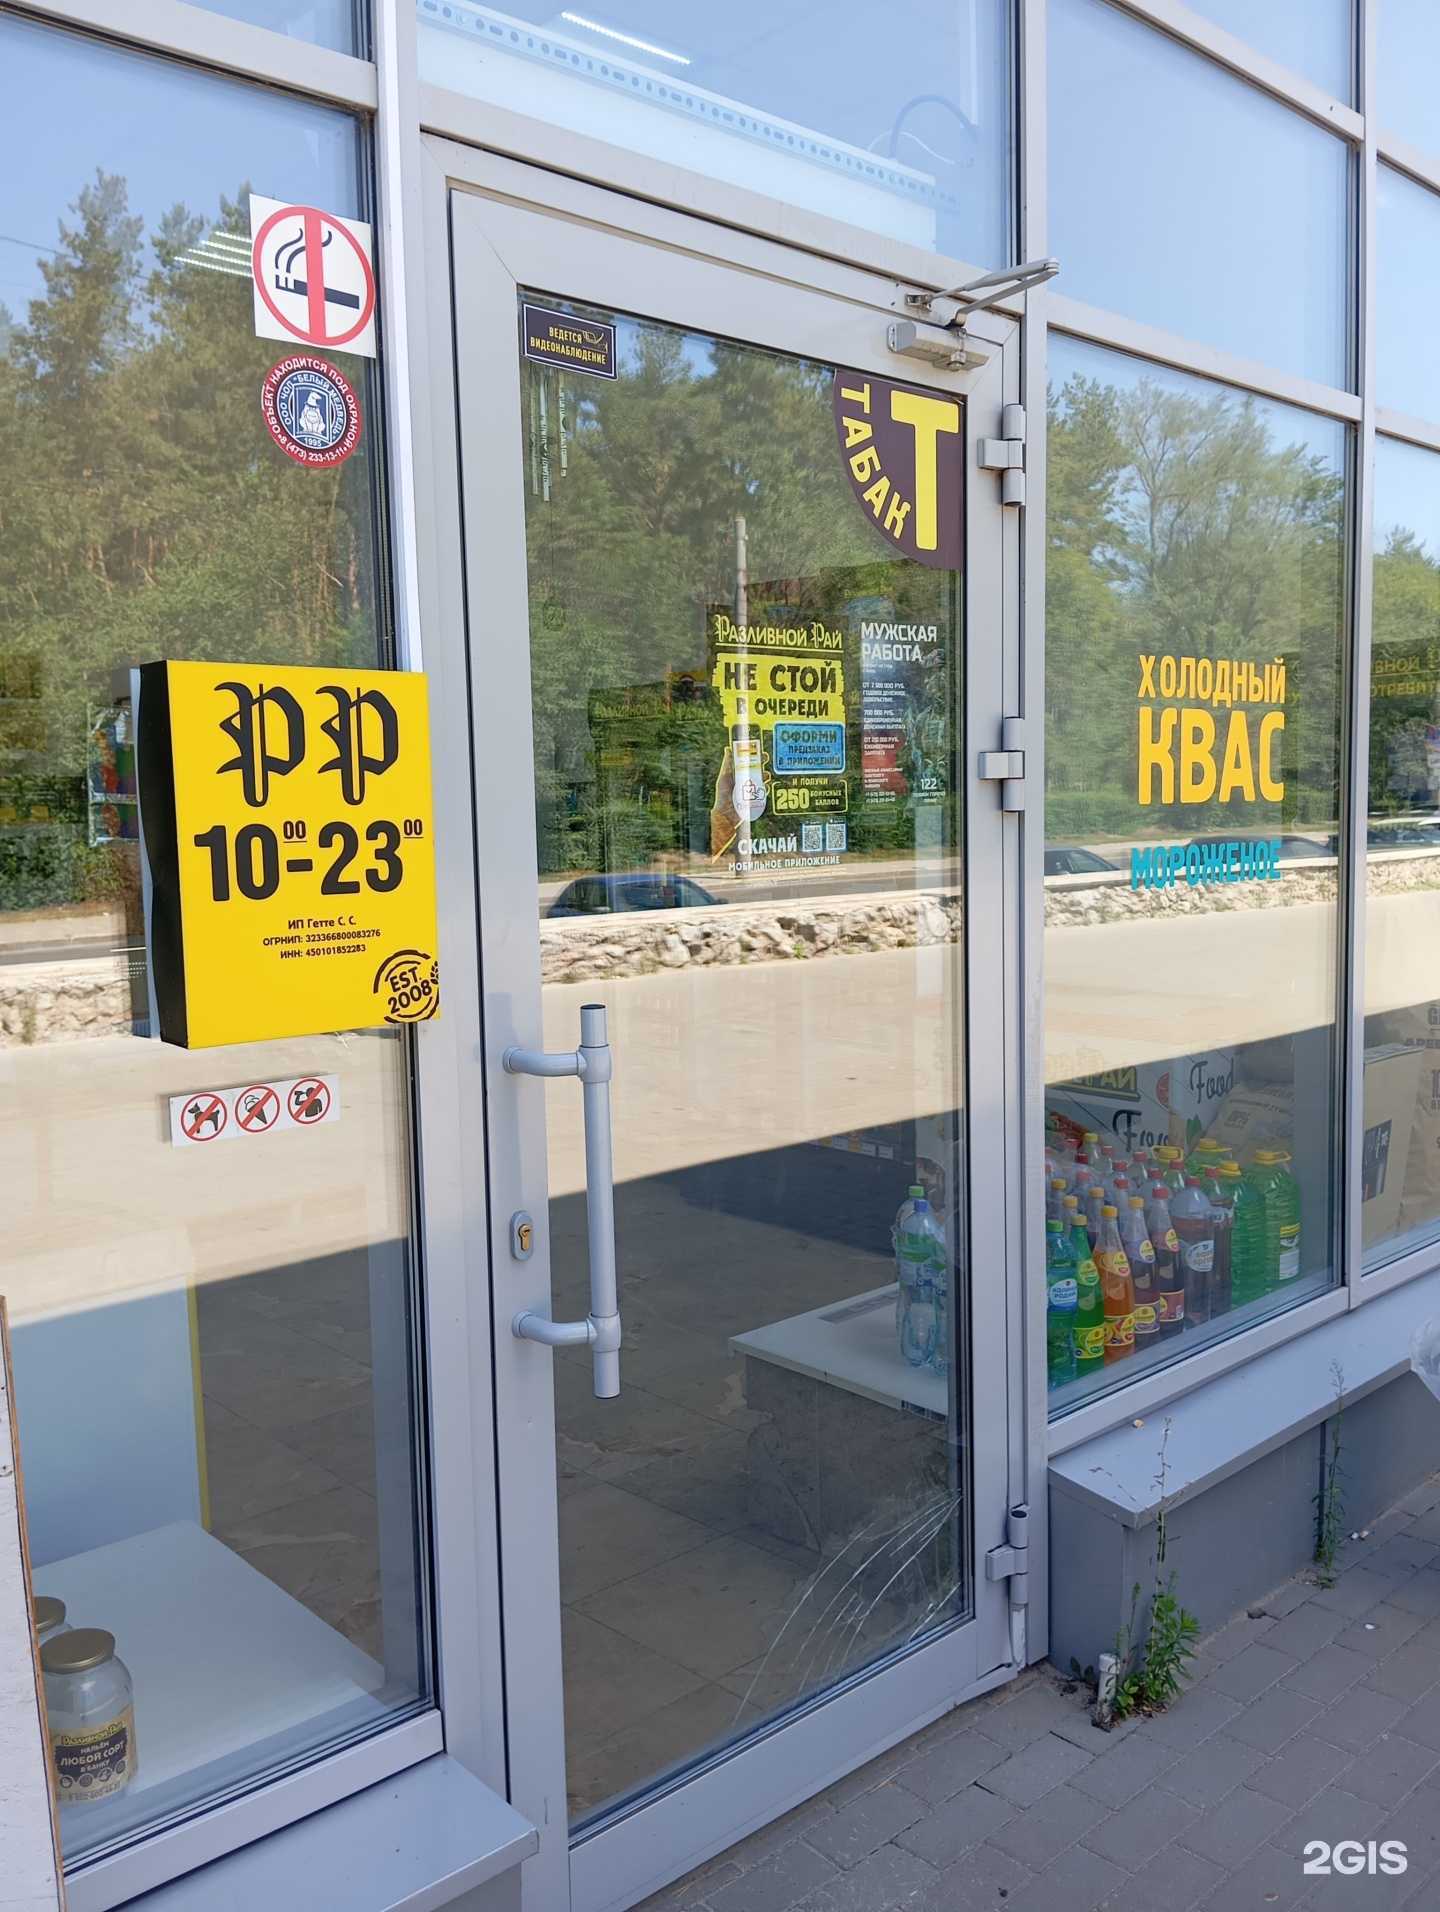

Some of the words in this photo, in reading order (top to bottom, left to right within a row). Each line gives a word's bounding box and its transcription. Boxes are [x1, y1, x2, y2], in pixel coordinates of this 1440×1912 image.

[549, 326, 582, 344] ВЕДЕТСЯ
[530, 336, 606, 365] ВИДЕОНАБЛЮДЕНИЕ
[270, 357, 328, 384] НАХОДИТСЯ
[328, 369, 349, 394] ПОД
[264, 384, 281, 434] ОБЪЕКТ
[343, 394, 358, 448] ОХРАНОЙ
[286, 441, 307, 460] (473)
[308, 447, 345, 462] 233-13-11
[304, 437, 322, 447] 1995
[841, 383, 911, 539] ТАБАК
[891, 390, 959, 551] Т
[861, 622, 937, 642] МУЖСКАЯ
[861, 642, 923, 663] РАБОТА
[724, 663, 757, 691] НЕ
[769, 660, 837, 693] СТОЙ
[1138, 655, 1286, 707] ХОЛОДНЫЙ
[754, 698, 829, 718] ОЧЕРЕДИ
[781, 730, 837, 744] ОФОРМИ
[788, 745, 830, 754] ПРЕДЗАКАЗ
[1138, 706, 1285, 805] КВАС
[792, 778, 798, 786] И
[800, 777, 829, 786] ПОЛУЧИ
[921, 778, 937, 790] 122
[776, 788, 810, 810] 250
[815, 798, 840, 806] БАЛЛОВ
[737, 833, 798, 855] СКАЧАЙ
[728, 858, 782, 872] МОБИЛЬНОЕ
[784, 855, 841, 868] ПРИЛОЖЕНИЕ
[1131, 838, 1282, 890] МОРОЖЕНОЕ
[288, 919, 304, 930] ИП
[307, 918, 335, 929] Гетте
[263, 935, 304, 946] ОГРНИП:
[280, 949, 303, 960] ИНН:
[389, 966, 423, 992] EST.
[387, 979, 433, 1014] 2008
